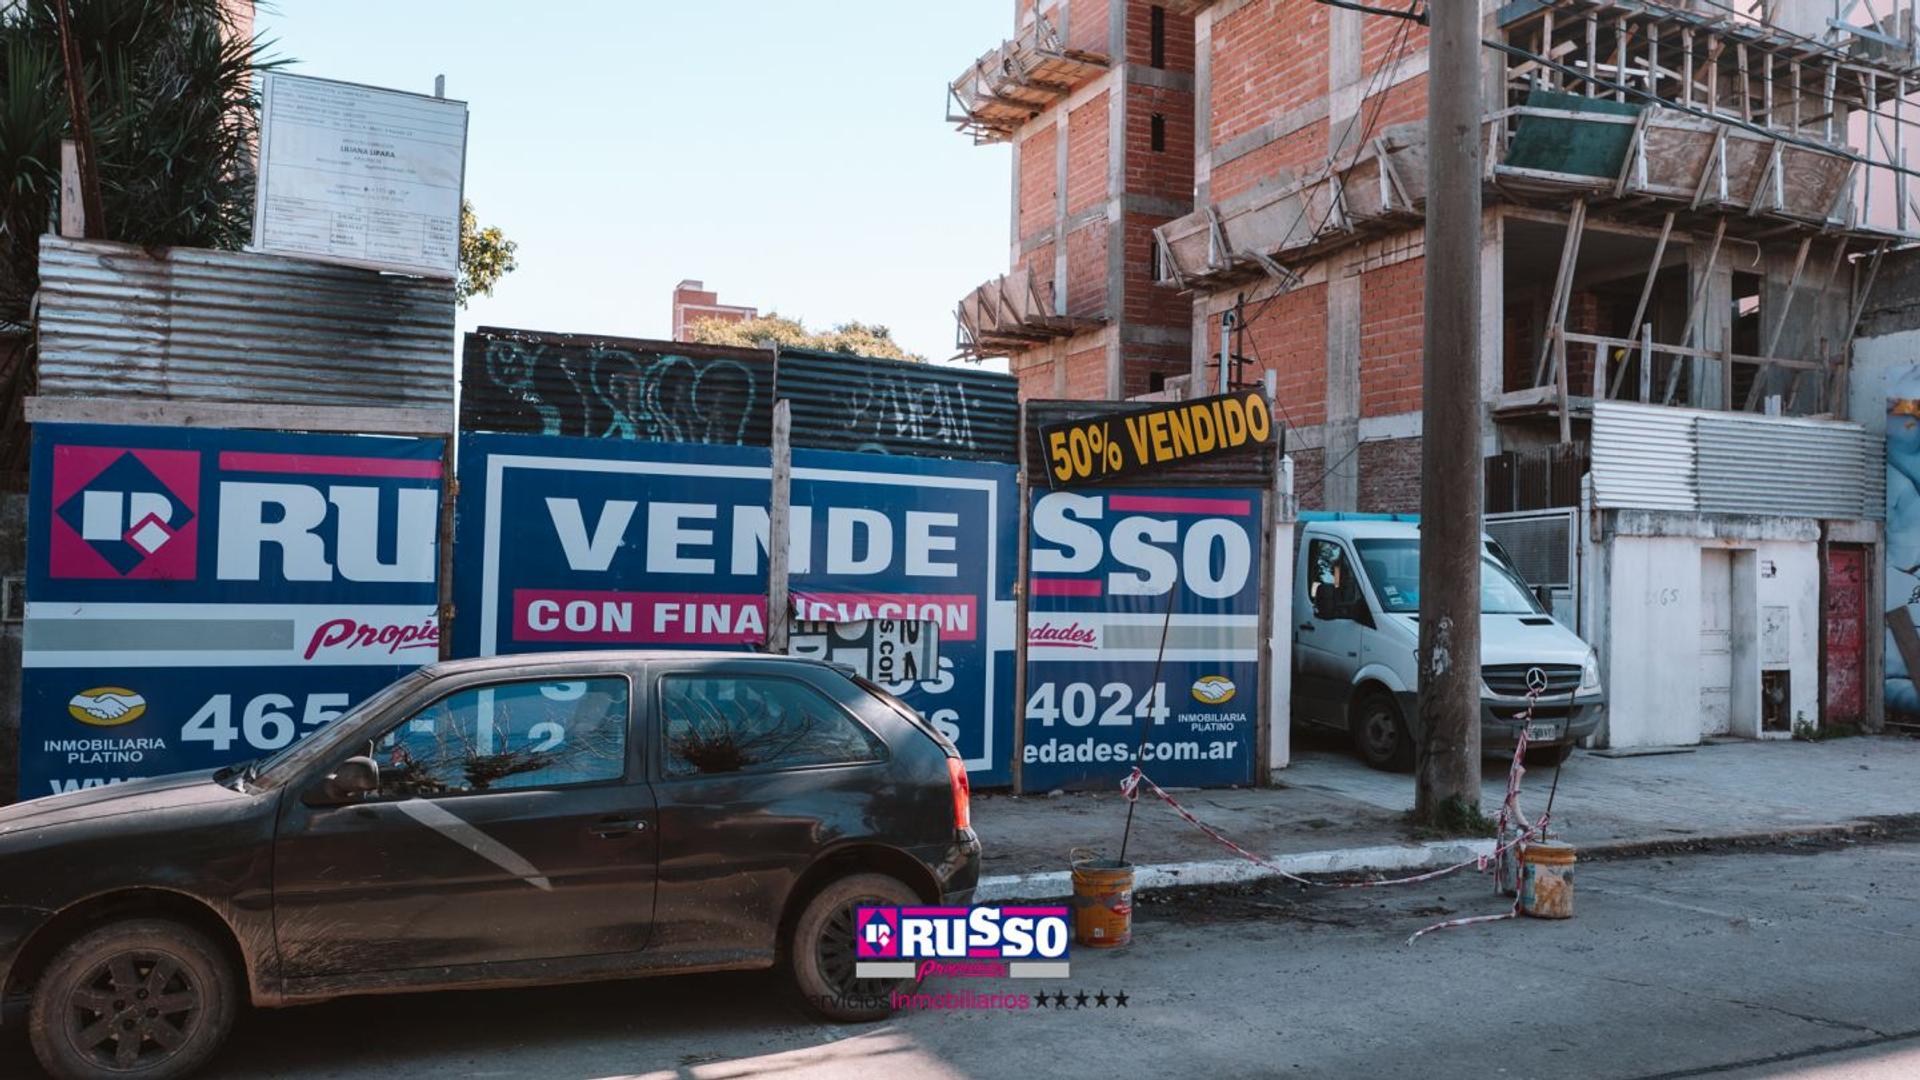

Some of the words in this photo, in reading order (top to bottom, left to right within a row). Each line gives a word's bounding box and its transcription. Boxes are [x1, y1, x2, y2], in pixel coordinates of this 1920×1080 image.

[1049, 421, 1123, 482] 50%
[1124, 393, 1271, 466] VENDIDO
[545, 496, 960, 578] VENDE
[526, 598, 633, 634] CON
[1025, 681, 1171, 728] 4024
[1177, 712, 1248, 723] INMOBILIARIA
[1190, 722, 1235, 732] PLATINO
[43, 737, 167, 753] INMOBILIARIA
[66, 750, 144, 765] PLATINO
[1023, 736, 1239, 764] edades.com.ar
